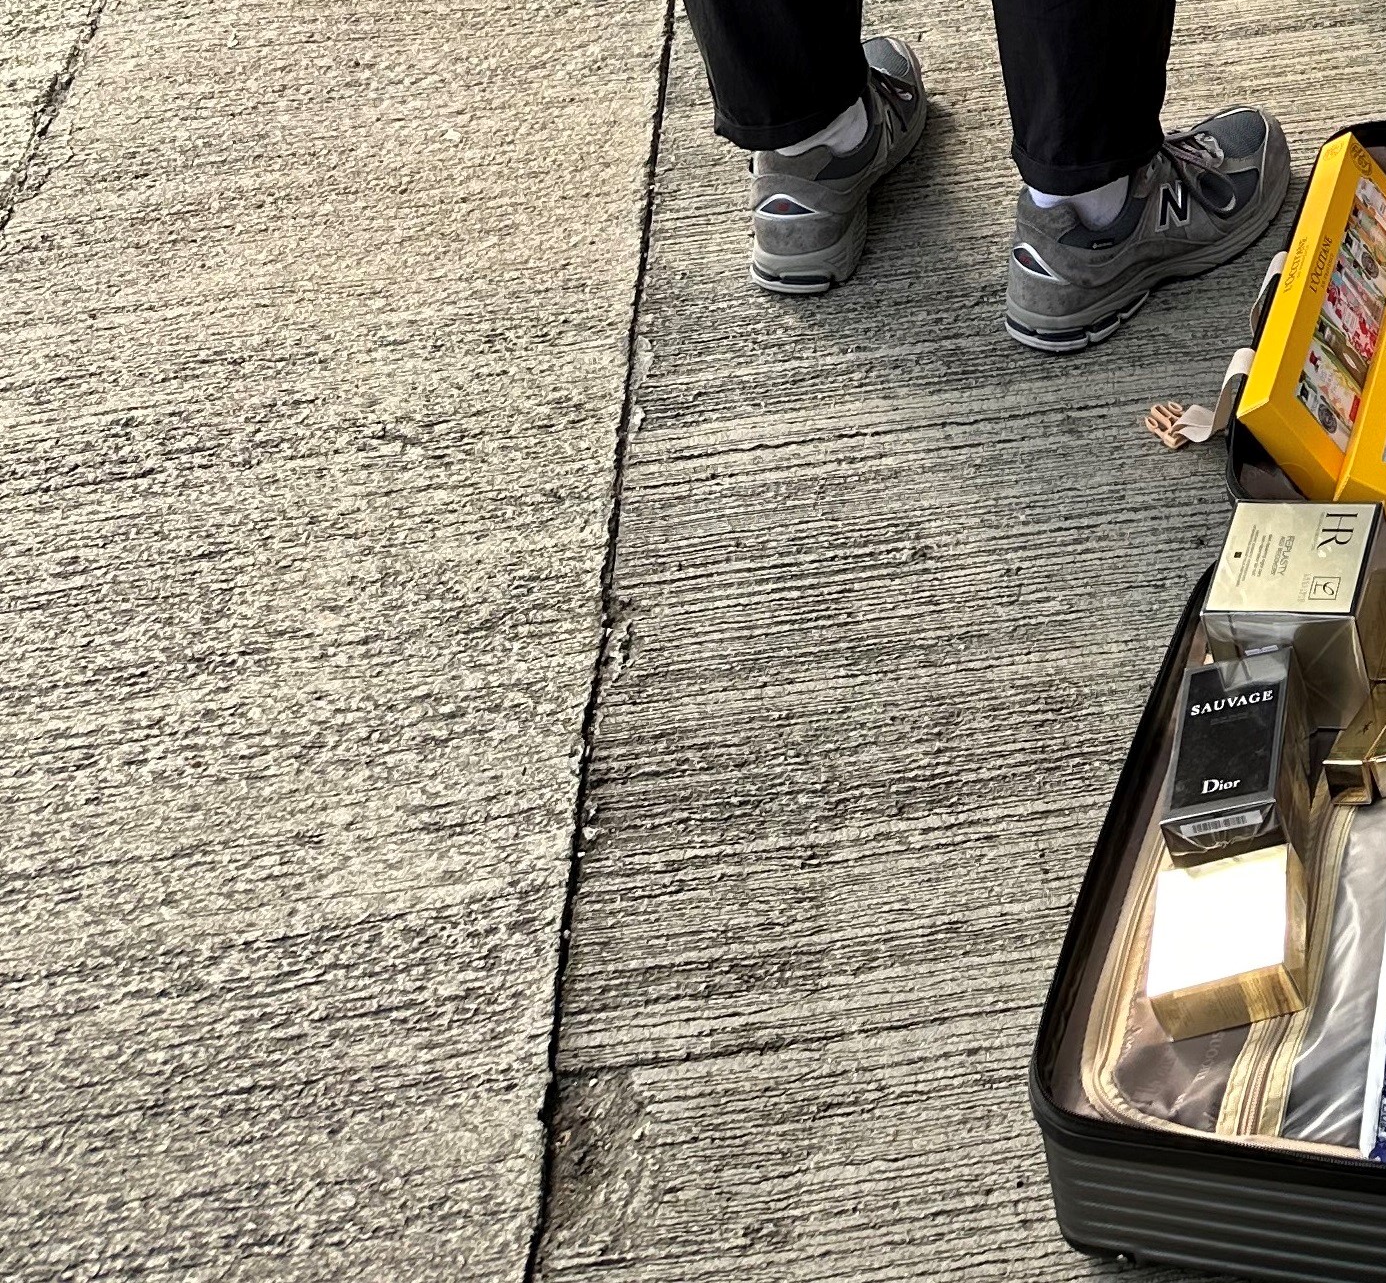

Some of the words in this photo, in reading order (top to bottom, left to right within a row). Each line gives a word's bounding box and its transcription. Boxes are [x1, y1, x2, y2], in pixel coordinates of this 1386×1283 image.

[1309, 236, 1332, 294] L'OCCITANE
[1190, 690, 1274, 716] SAUVAGE
[1201, 778, 1241, 795] Dior
